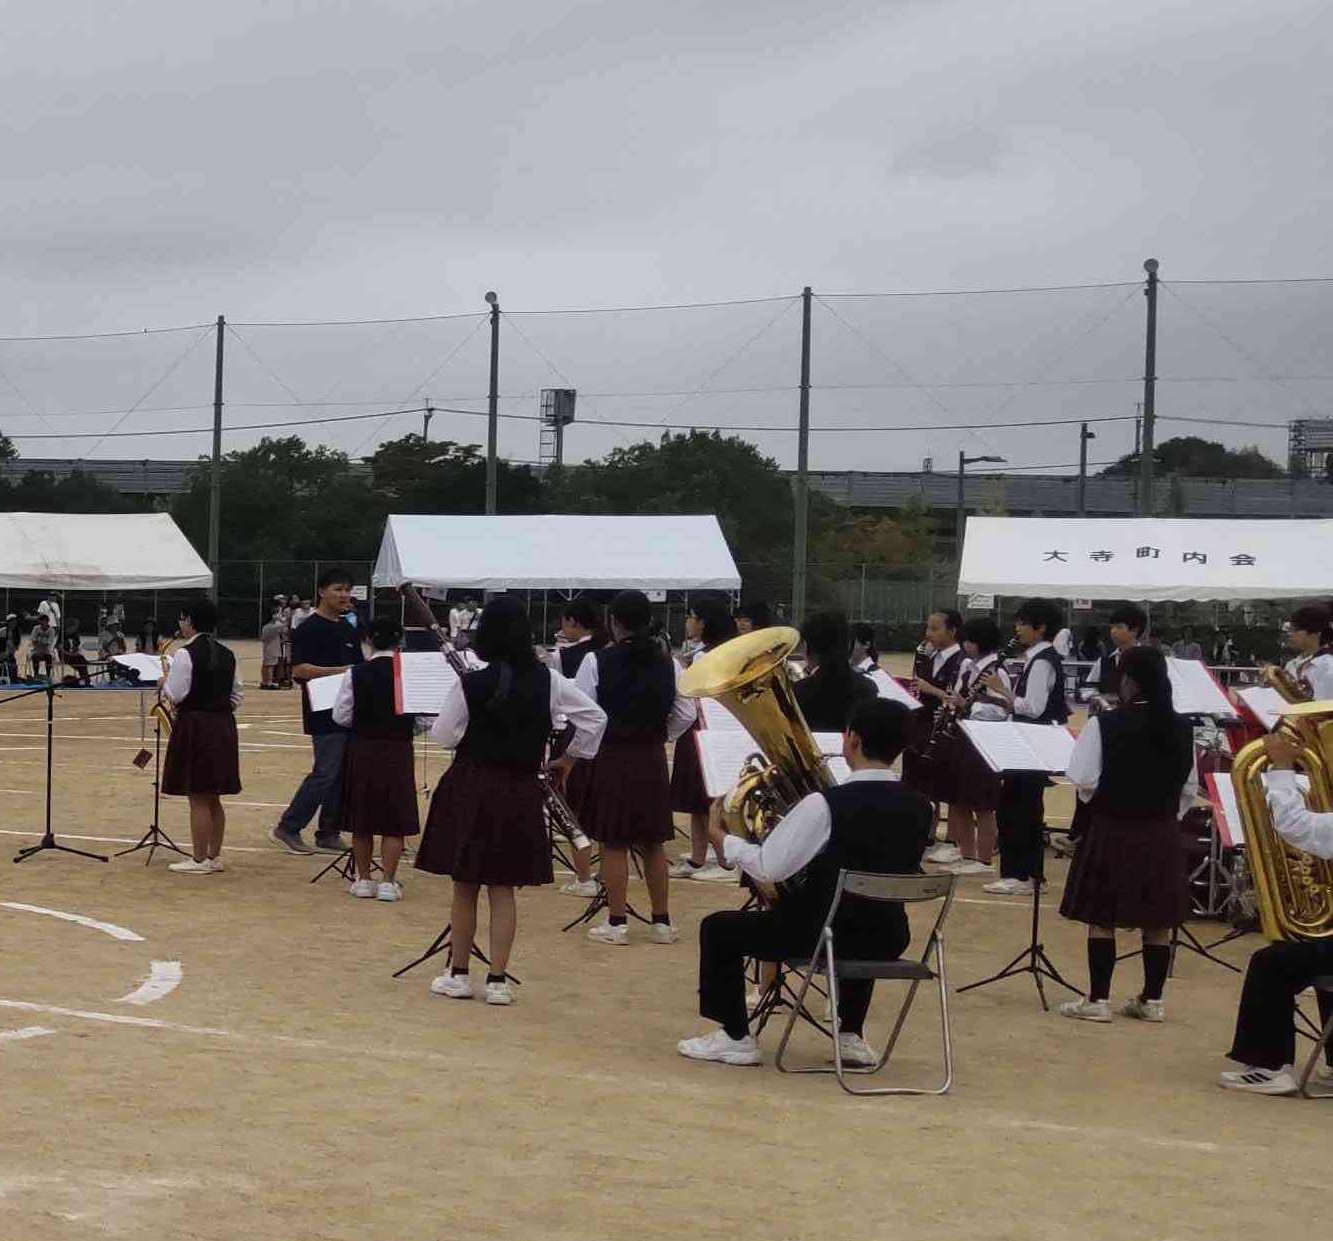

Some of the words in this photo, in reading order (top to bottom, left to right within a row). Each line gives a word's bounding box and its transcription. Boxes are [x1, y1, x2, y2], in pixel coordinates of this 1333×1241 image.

[1043, 545, 1257, 567] 大寺町内会
